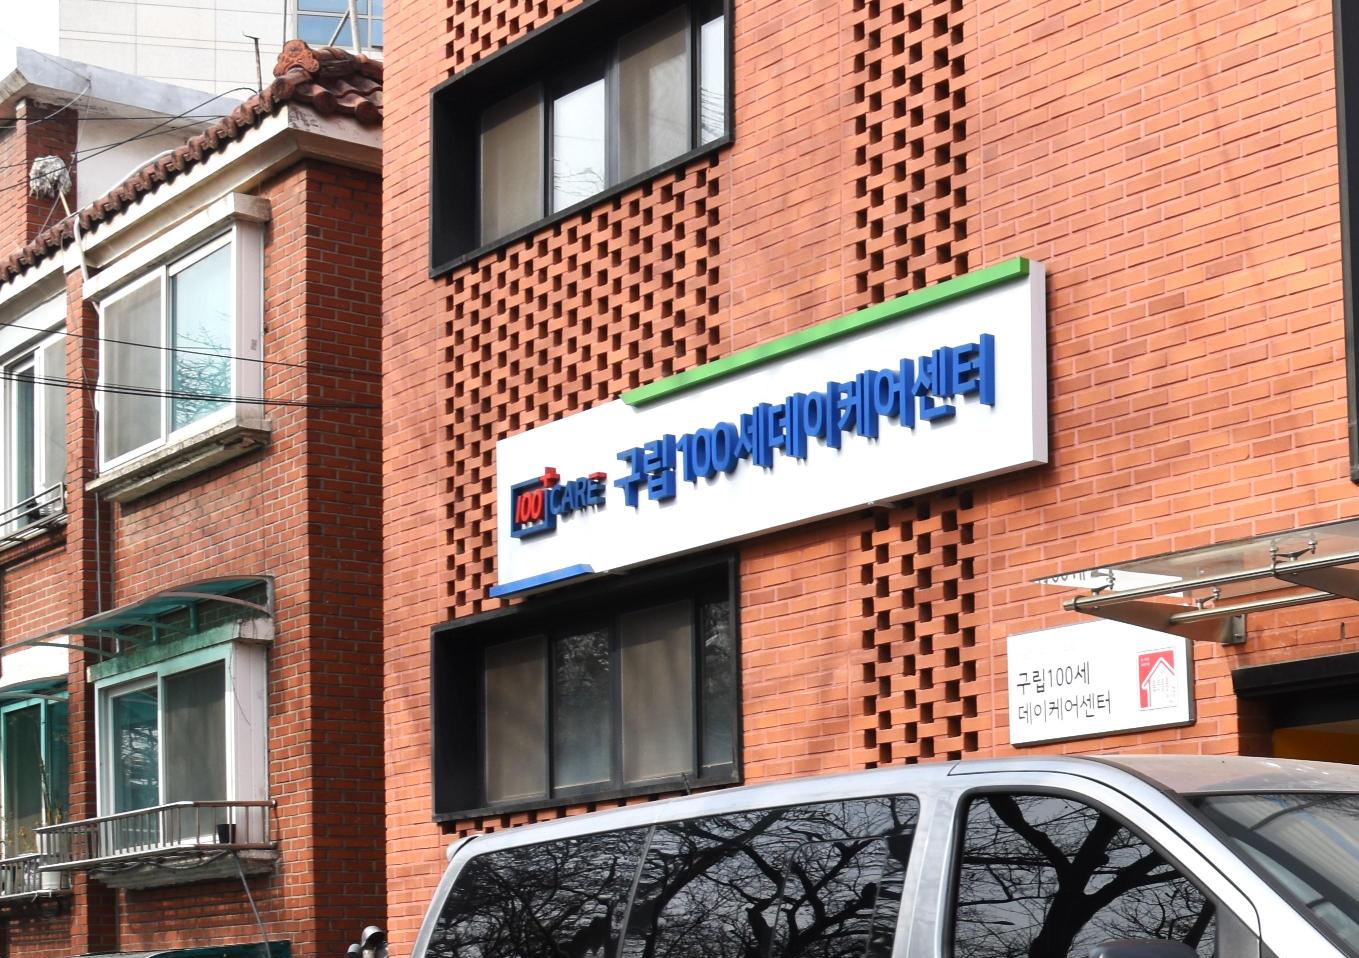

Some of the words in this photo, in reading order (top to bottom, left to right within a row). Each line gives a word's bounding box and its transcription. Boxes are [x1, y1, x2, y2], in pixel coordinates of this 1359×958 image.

[515, 489, 545, 524] 100
[1017, 661, 1090, 695] 구립100세
[1018, 690, 1111, 725] 데이케어센터
